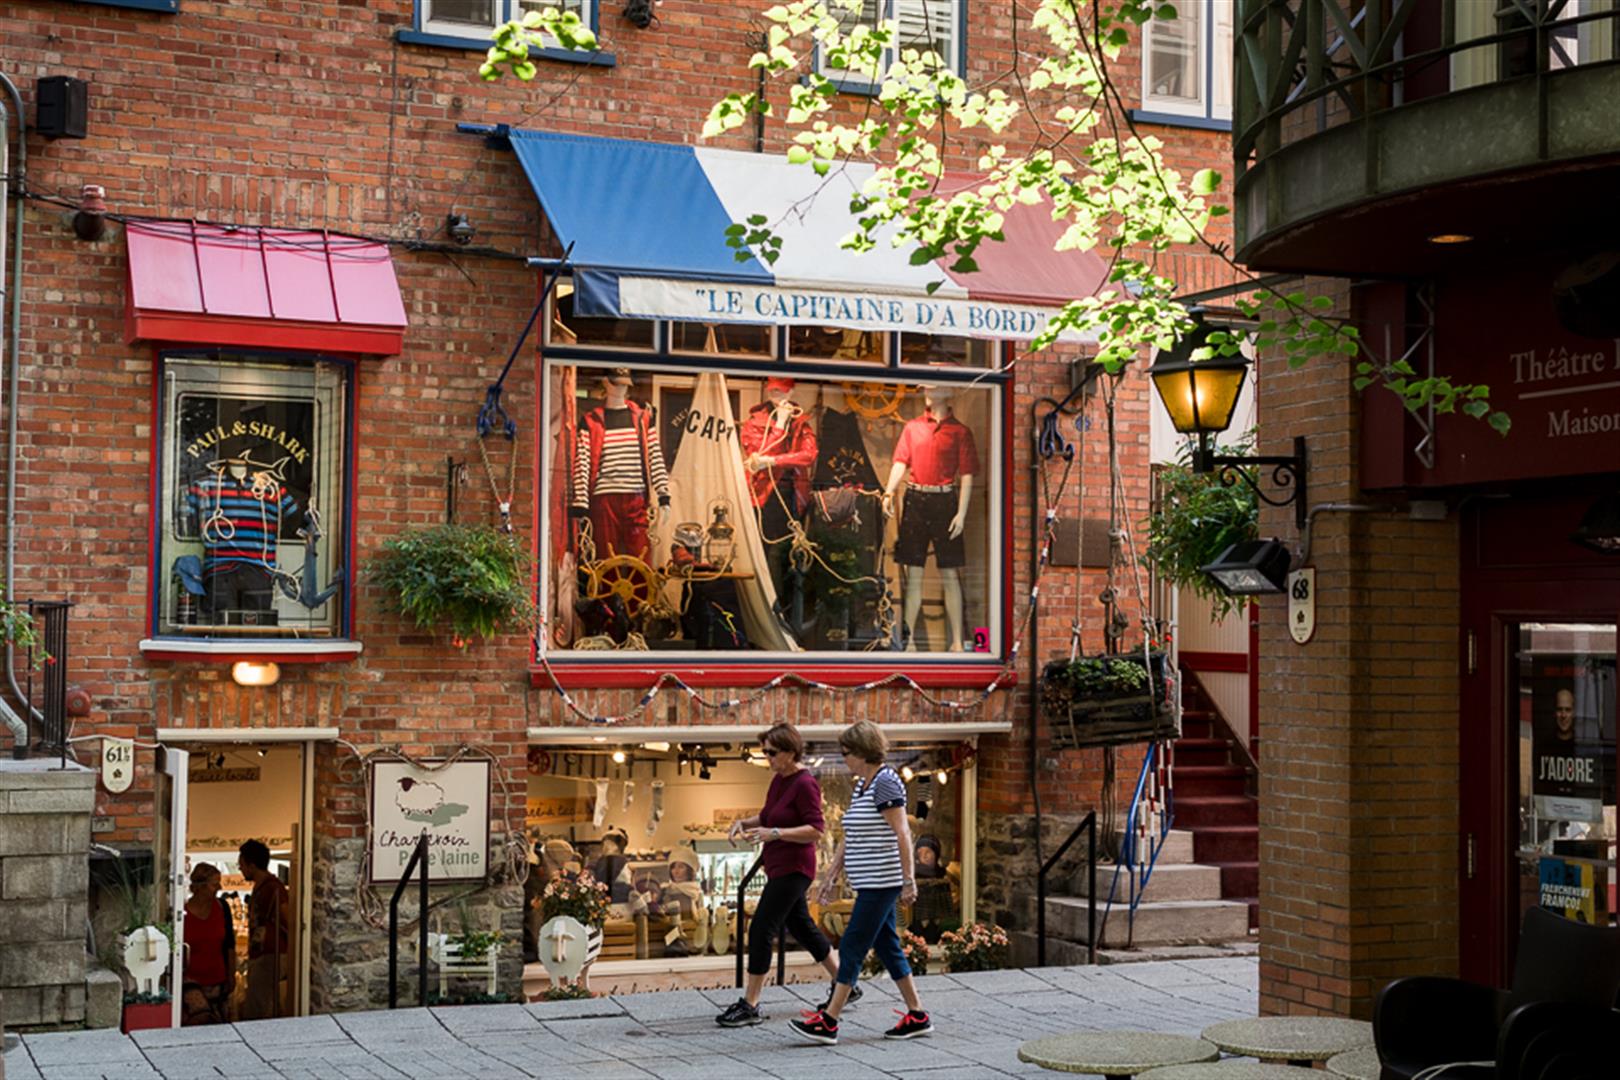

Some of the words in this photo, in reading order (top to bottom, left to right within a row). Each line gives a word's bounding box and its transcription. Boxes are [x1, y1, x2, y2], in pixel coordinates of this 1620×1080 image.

[694, 288, 743, 315] "LE
[755, 292, 903, 323] CAPITAINE
[916, 302, 957, 327] D'A
[968, 306, 1045, 333] BORD"
[1510, 345, 1606, 384] Théâtre
[187, 426, 231, 458] PAUL
[232, 420, 247, 436] &
[249, 421, 310, 464] SHARK
[1292, 578, 1309, 600] 68
[1538, 755, 1595, 784] J'ADORE
[399, 850, 436, 866] Pe
[440, 848, 480, 865] laine
